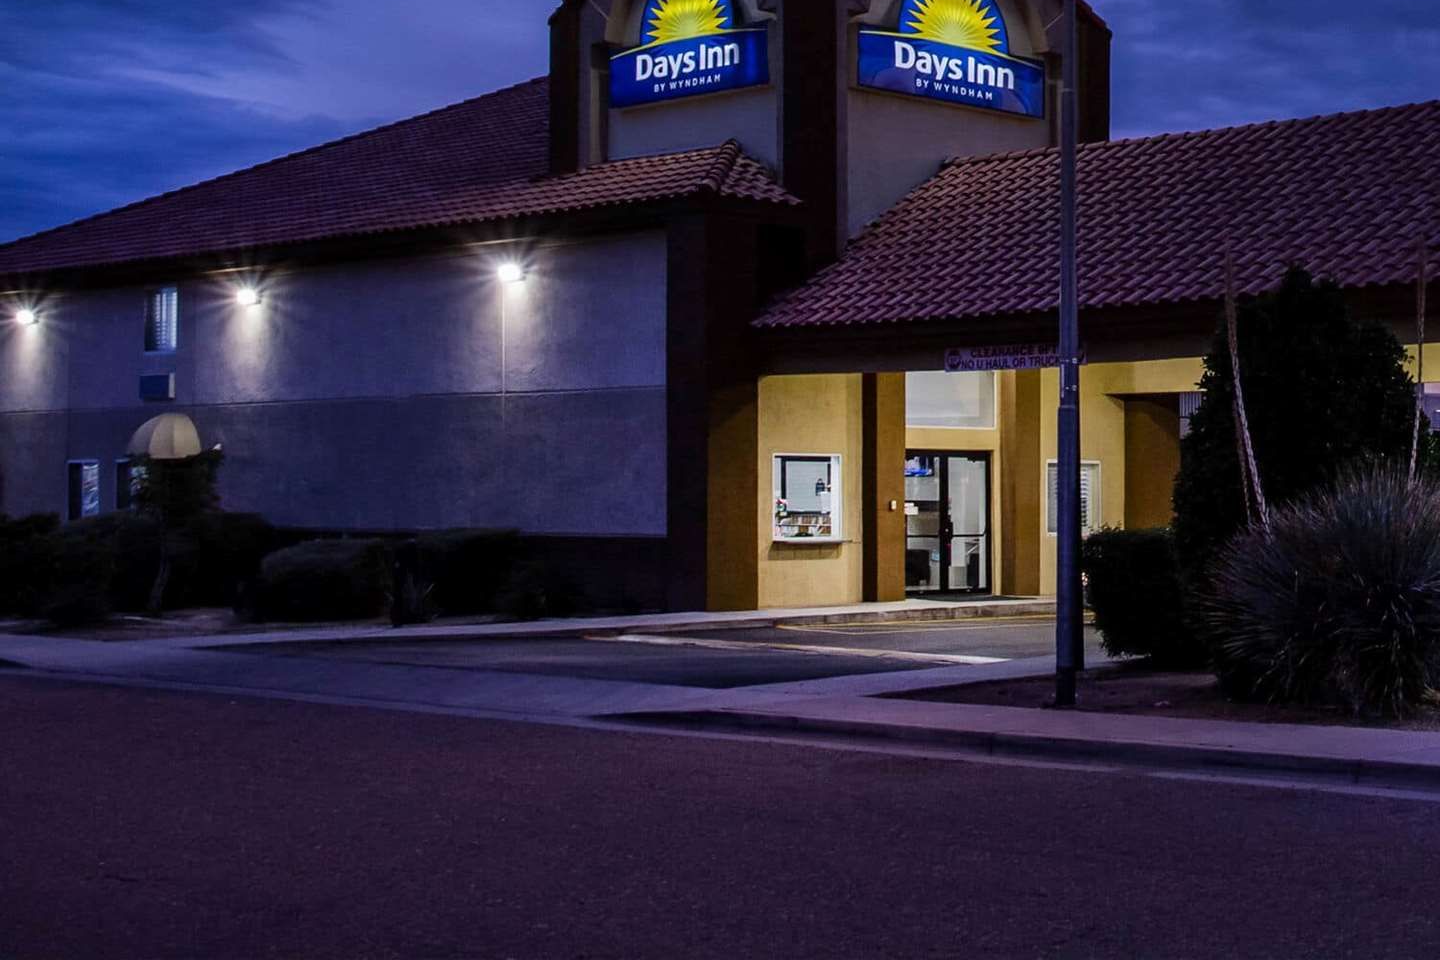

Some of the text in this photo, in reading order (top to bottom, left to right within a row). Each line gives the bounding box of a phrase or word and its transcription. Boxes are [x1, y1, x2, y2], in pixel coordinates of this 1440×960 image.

[635, 42, 740, 81] Days Inn
[894, 40, 1014, 89] Days Inn
[653, 74, 721, 93] BY WYNDHAM
[915, 78, 993, 100] BY WYNDHAM
